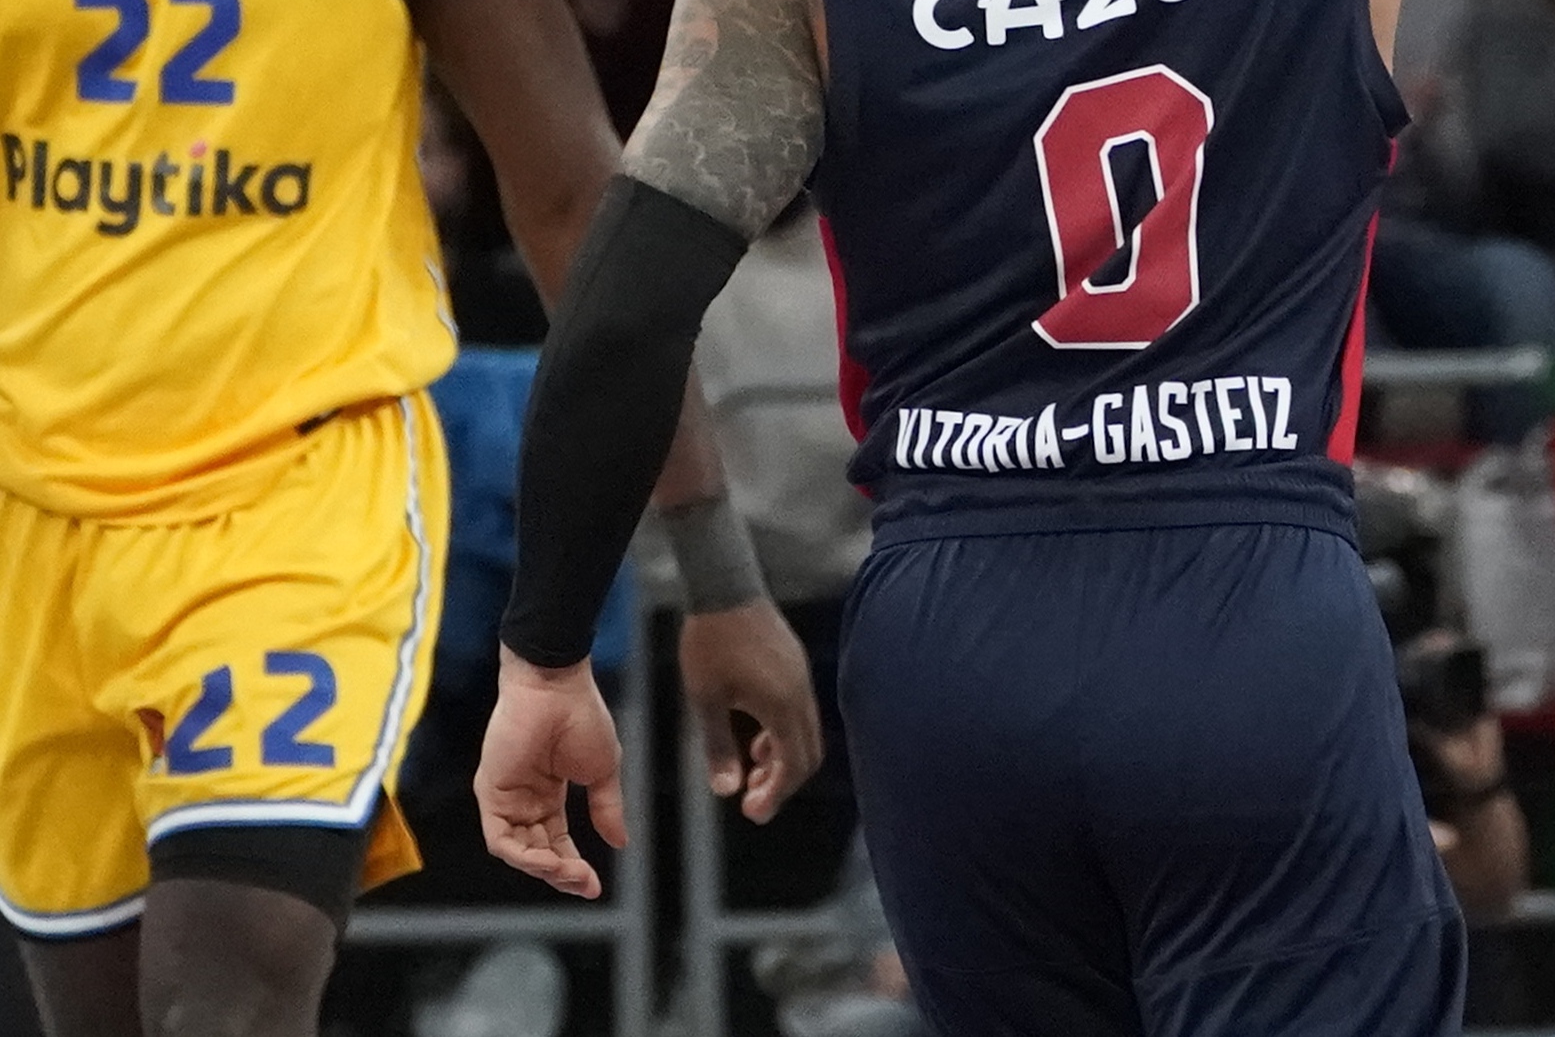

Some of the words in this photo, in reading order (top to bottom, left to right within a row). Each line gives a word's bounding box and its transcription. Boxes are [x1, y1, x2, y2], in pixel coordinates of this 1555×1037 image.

[1, 132, 313, 238] Playtika
[1031, 63, 1215, 350] 0
[895, 376, 1299, 474] VITORIA-GASTEIZ
[164, 649, 338, 777] 22
